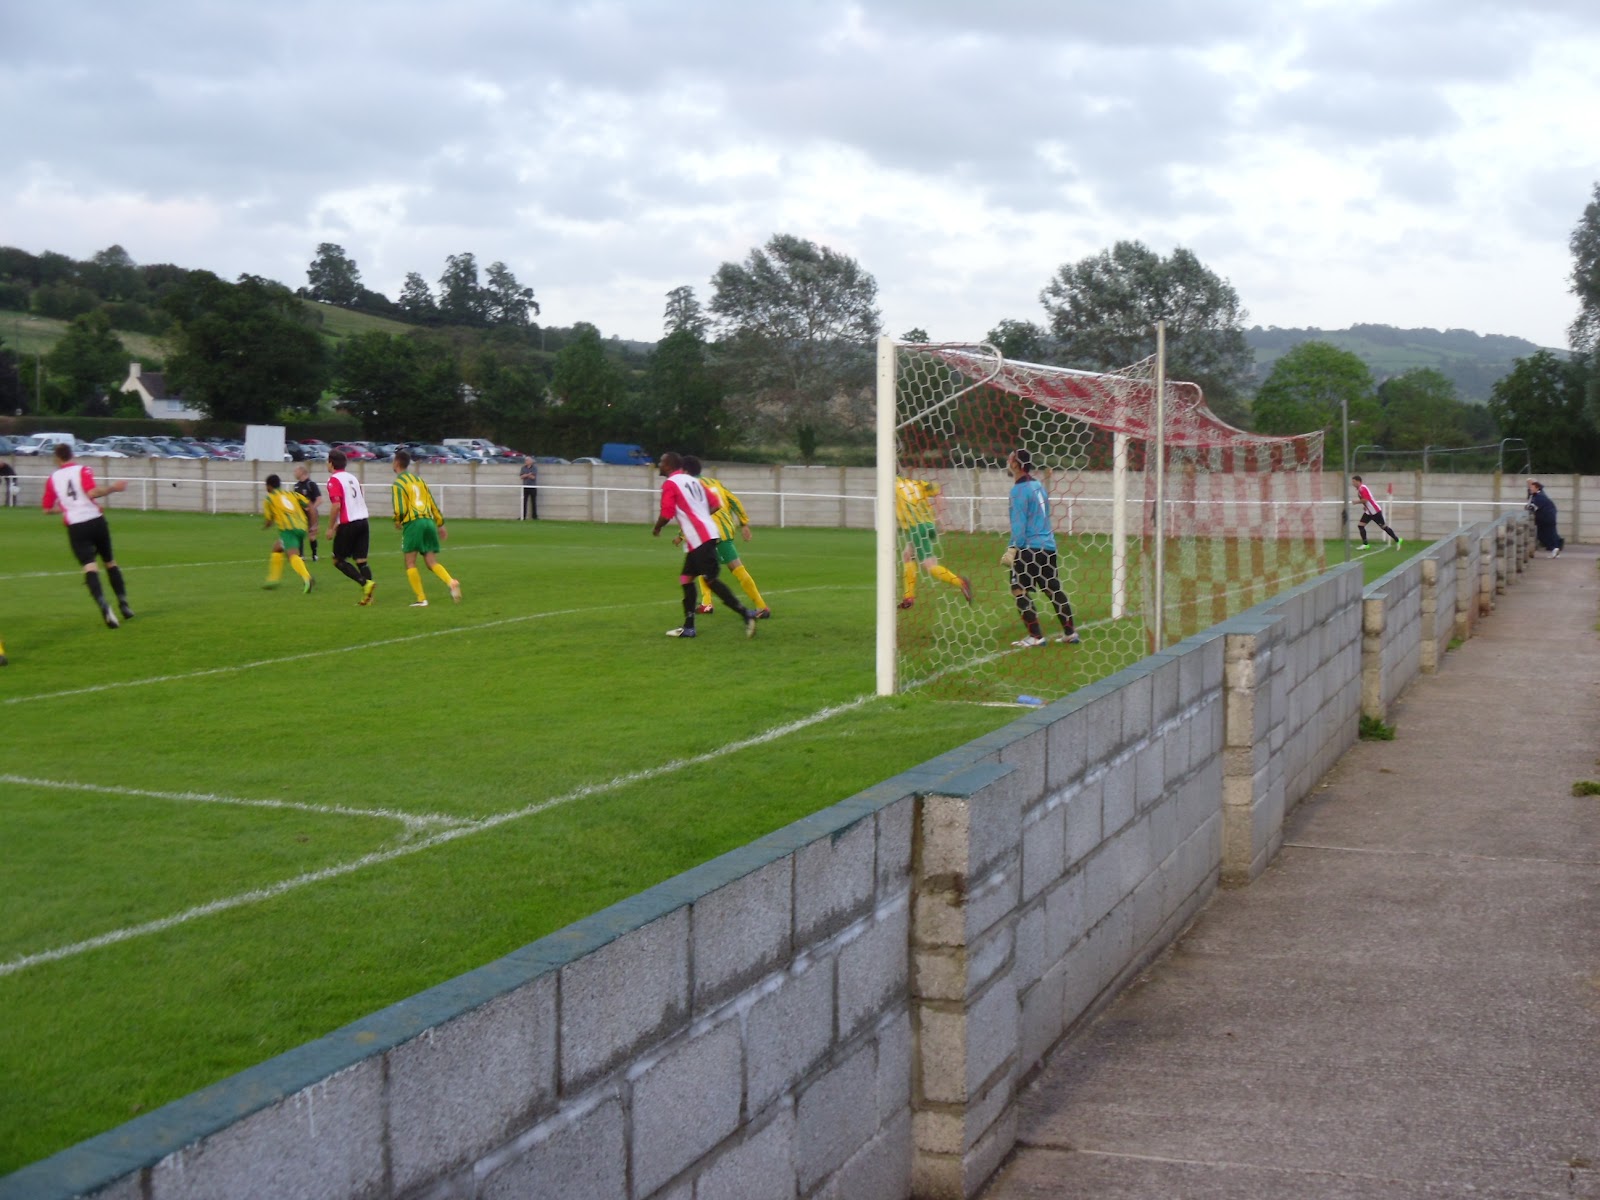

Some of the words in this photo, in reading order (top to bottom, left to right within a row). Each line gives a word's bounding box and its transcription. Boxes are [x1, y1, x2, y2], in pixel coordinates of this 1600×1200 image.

[66, 480, 77, 501] 4
[412, 484, 425, 507] 2
[684, 481, 703, 502] 10
